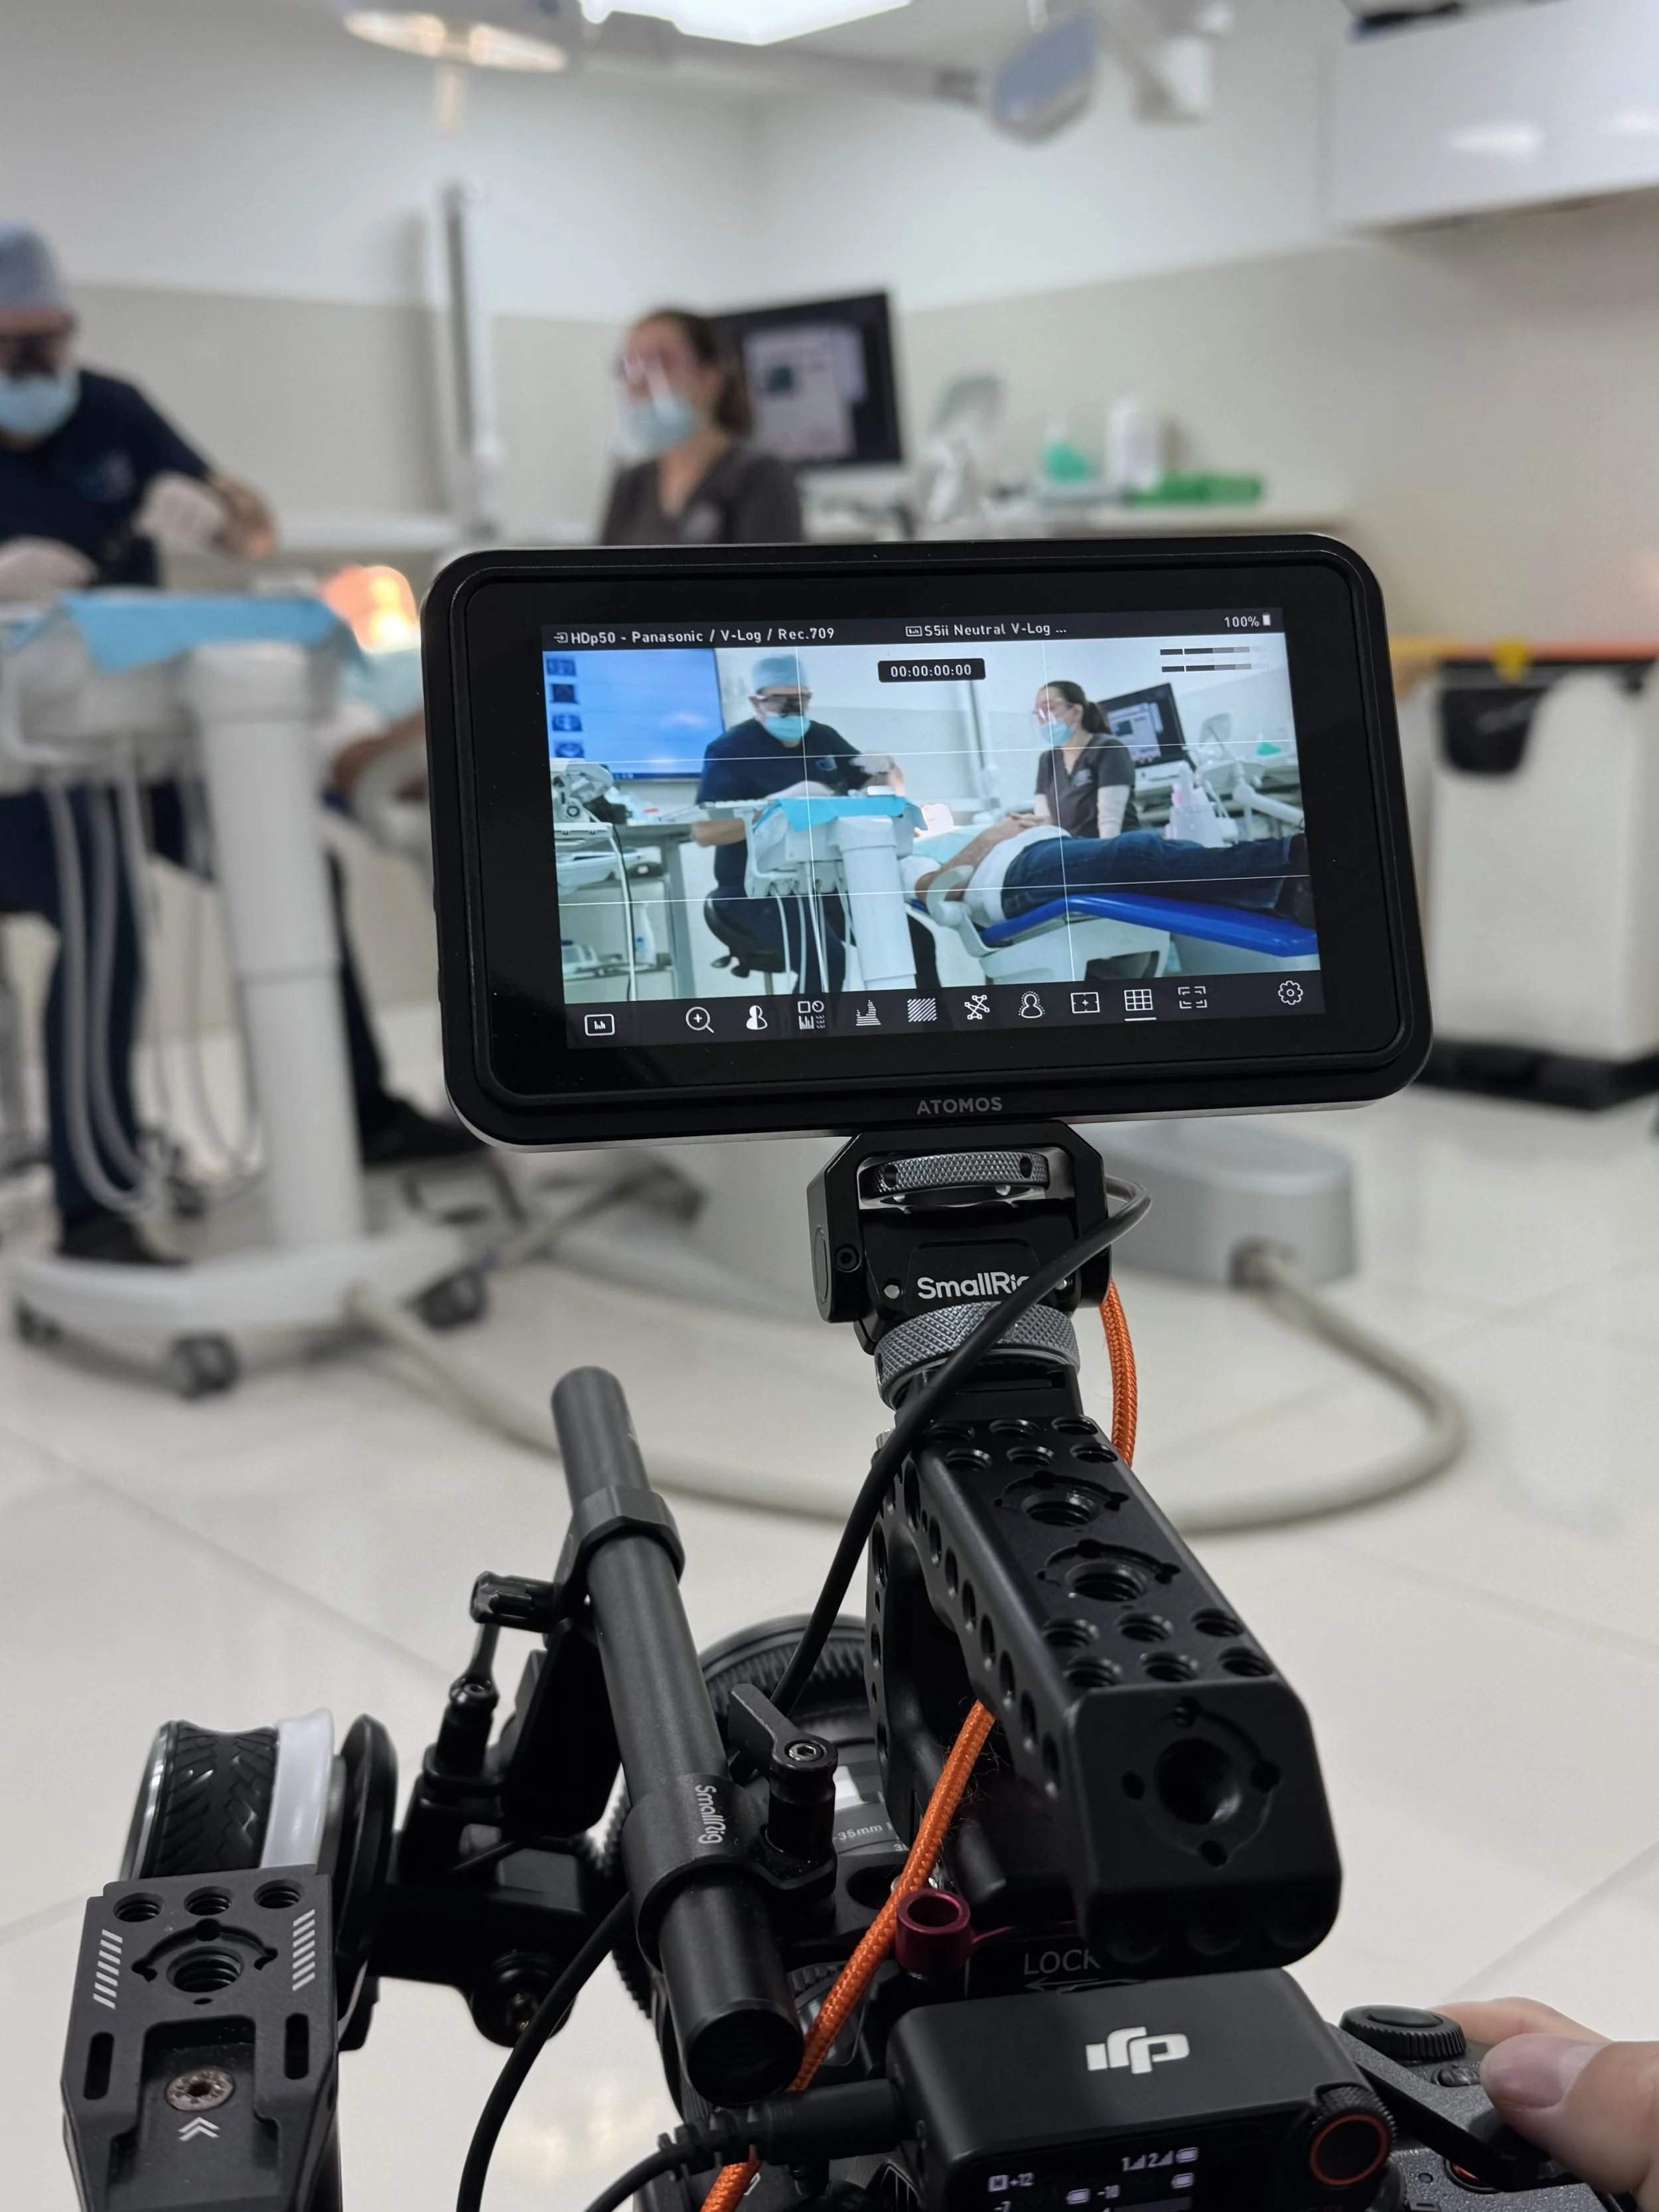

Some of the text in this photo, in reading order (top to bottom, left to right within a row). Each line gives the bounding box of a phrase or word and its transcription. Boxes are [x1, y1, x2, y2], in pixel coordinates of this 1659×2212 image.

[924, 625, 949, 636] S5ii
[954, 623, 1006, 636] Neutral
[1011, 623, 1050, 636] V-Log
[1224, 616, 1260, 628] 100%
[571, 631, 616, 646] HDp50
[632, 630, 703, 643] Panasonic
[721, 628, 761, 643] V-Log
[778, 627, 834, 640] Rec.709
[891, 664, 972, 678] 00:00:00:00
[916, 1096, 1003, 1115] ATOMOS
[917, 1272, 1029, 1299] SmallRi
[694, 1785, 726, 1844] SmallRig
